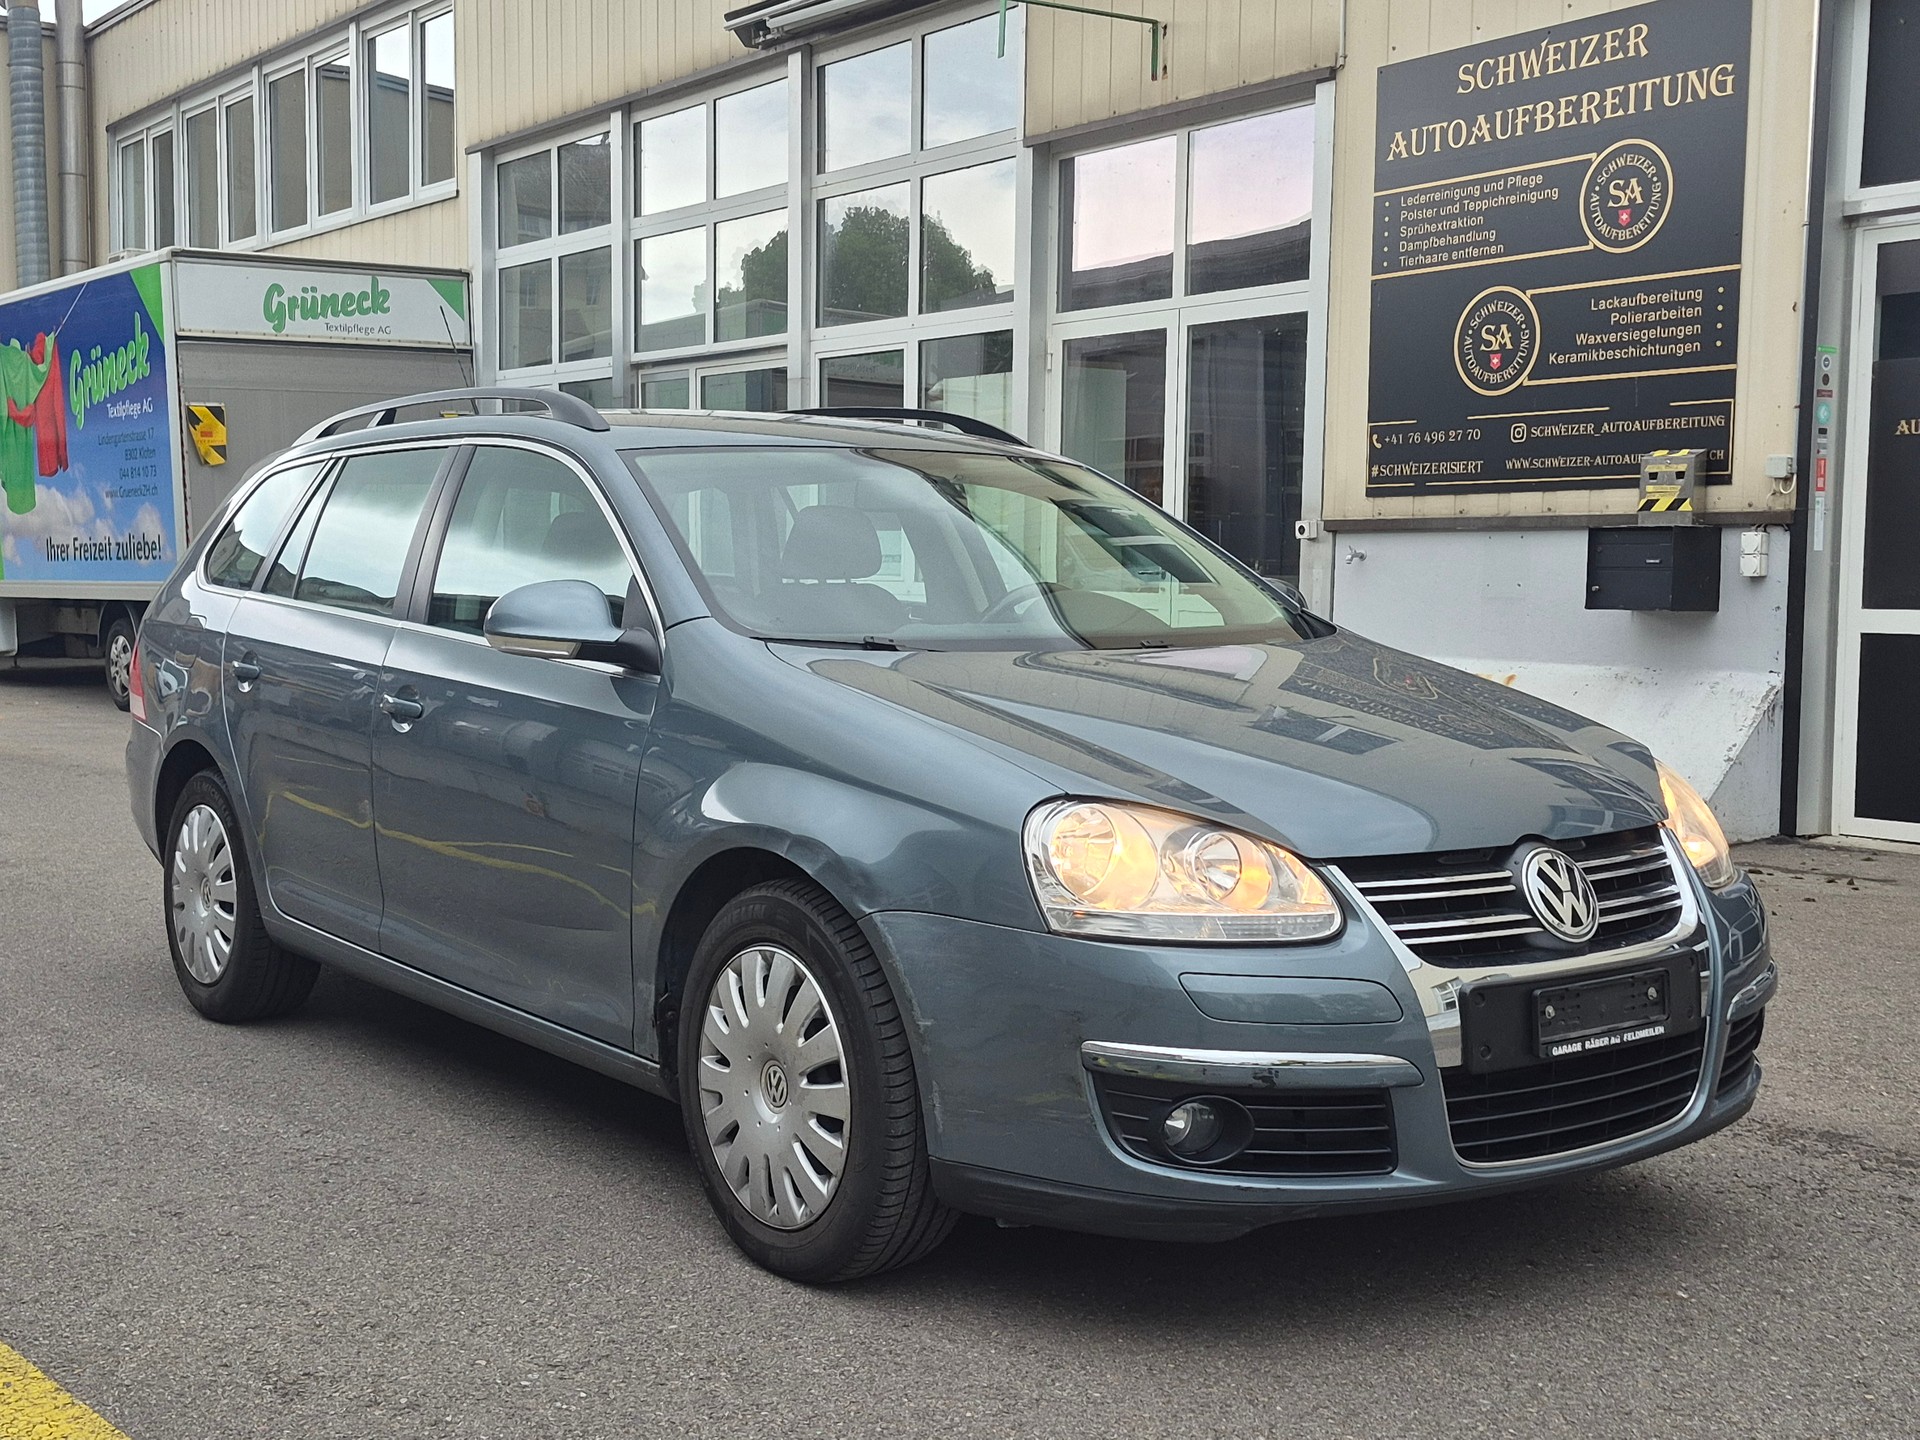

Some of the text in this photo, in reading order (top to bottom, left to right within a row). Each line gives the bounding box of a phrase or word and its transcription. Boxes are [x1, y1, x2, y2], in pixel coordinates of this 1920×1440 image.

[1457, 23, 1649, 94] SCHWEIZER
[1386, 63, 1735, 162] AUTOAUFBEREITUNG
[1597, 153, 1657, 185] SCHWEIZER
[1401, 174, 1543, 207] Lederreinigung und Pflege
[1607, 178, 1644, 207] SA
[1400, 187, 1559, 222] Polster und Teppichreinigung
[1590, 182, 1662, 240] AUTOAUFBEREITUNG
[1400, 215, 1484, 241] Sprühextraktion
[1400, 229, 1496, 253] Dampfbehandlung
[1399, 243, 1504, 267] Tierhaare entfernen
[263, 276, 391, 334] Grüneck
[1591, 289, 1703, 311] Lackaufbereitung
[1470, 300, 1525, 329] SCHWEIZER
[1610, 306, 1702, 326] Polierarbeiten
[325, 322, 392, 336] Textilpflege AG
[1480, 324, 1513, 350] SA
[1576, 324, 1701, 346] Waxversiegelungen
[1464, 329, 1530, 384] AUTOAUFBEREITUNG
[1549, 341, 1701, 365] Keramikbeschichtungen
[69, 311, 151, 431] Grüneck
[107, 397, 153, 420] Textilpflege AG
[1384, 428, 1481, 445] +41 76 496 27 70
[1530, 415, 1725, 438] SCHWEIZER_AUTOAUFBEREITUNG
[1371, 460, 1484, 478] #SCHWEIZERISIERT
[46, 532, 161, 562] Ihrer Freizeit zuliebe!
[1552, 1042, 1582, 1056] GARAGE
[1610, 1035, 1621, 1045] AG
